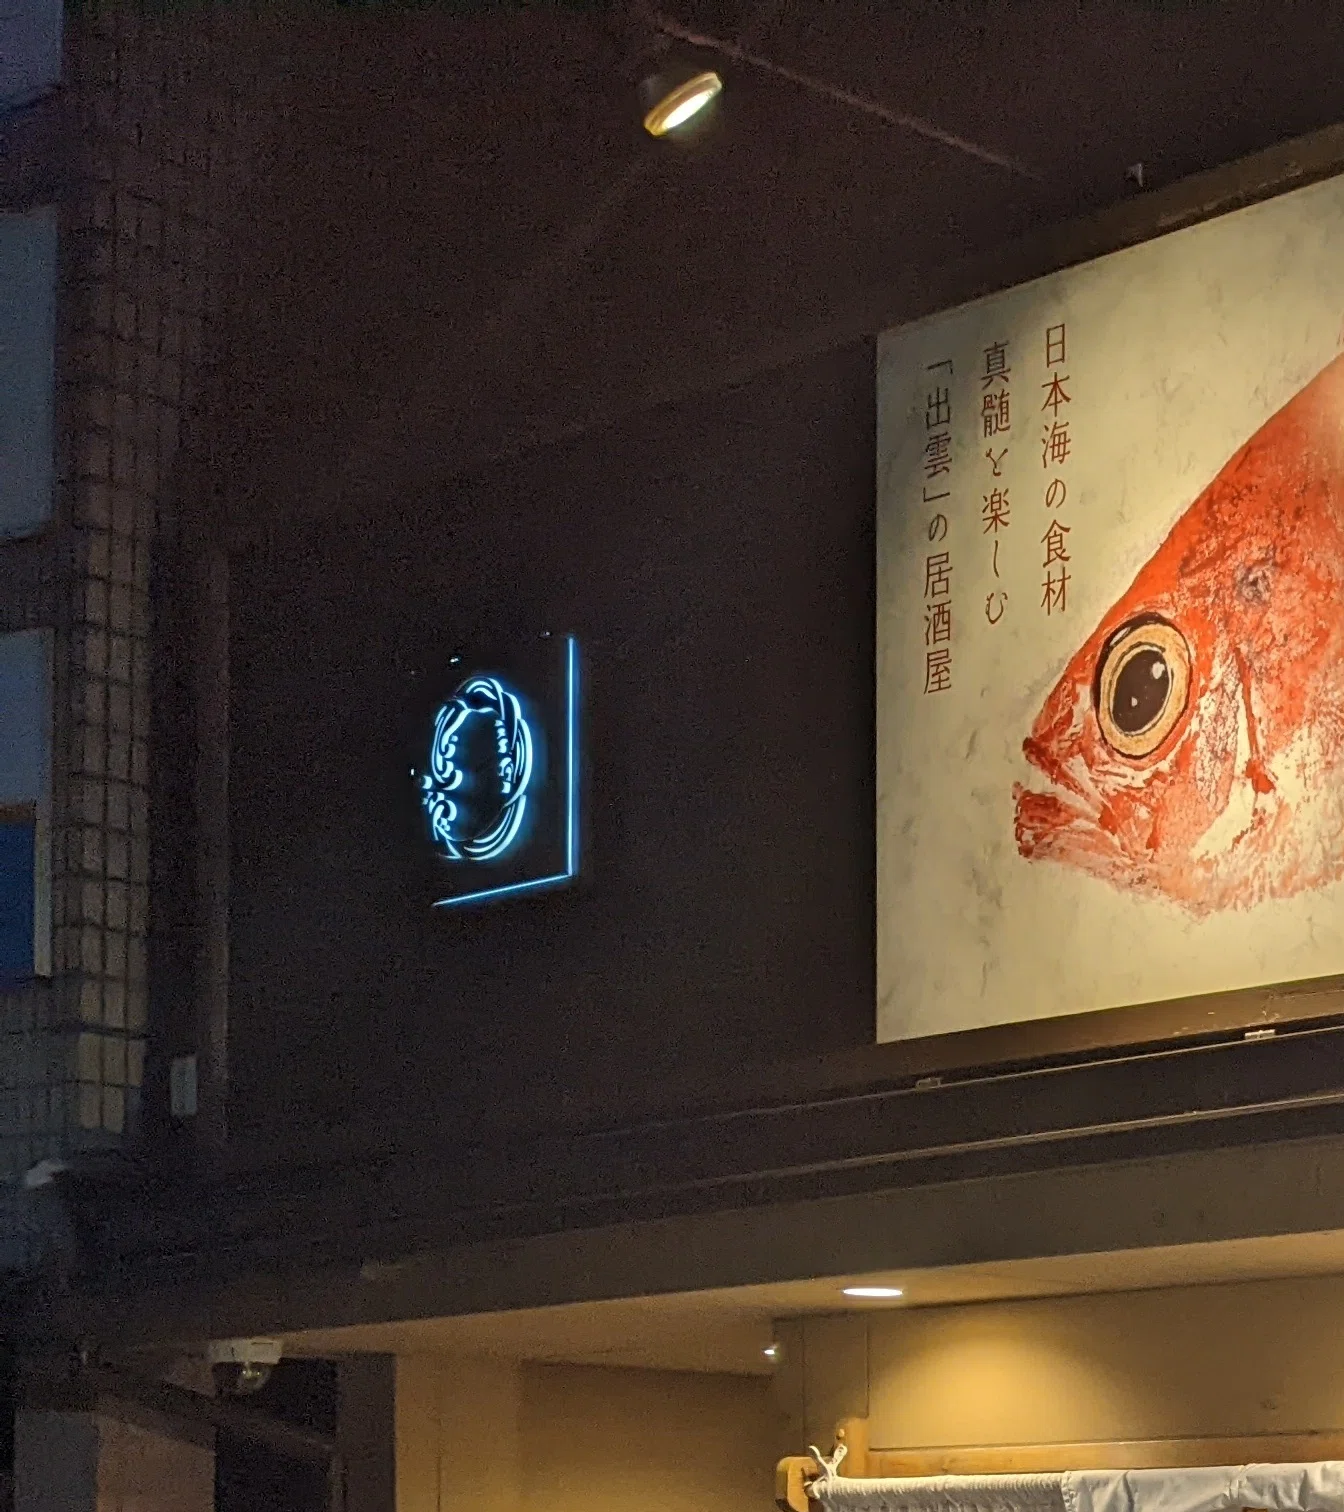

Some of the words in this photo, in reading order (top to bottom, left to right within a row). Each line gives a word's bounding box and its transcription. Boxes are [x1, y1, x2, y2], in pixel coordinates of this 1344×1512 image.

[923, 359, 953, 695] 「出雲」の居酒屋
[981, 341, 1010, 625] 真髄を楽しむ
[1041, 323, 1071, 616] 日本海の食材
